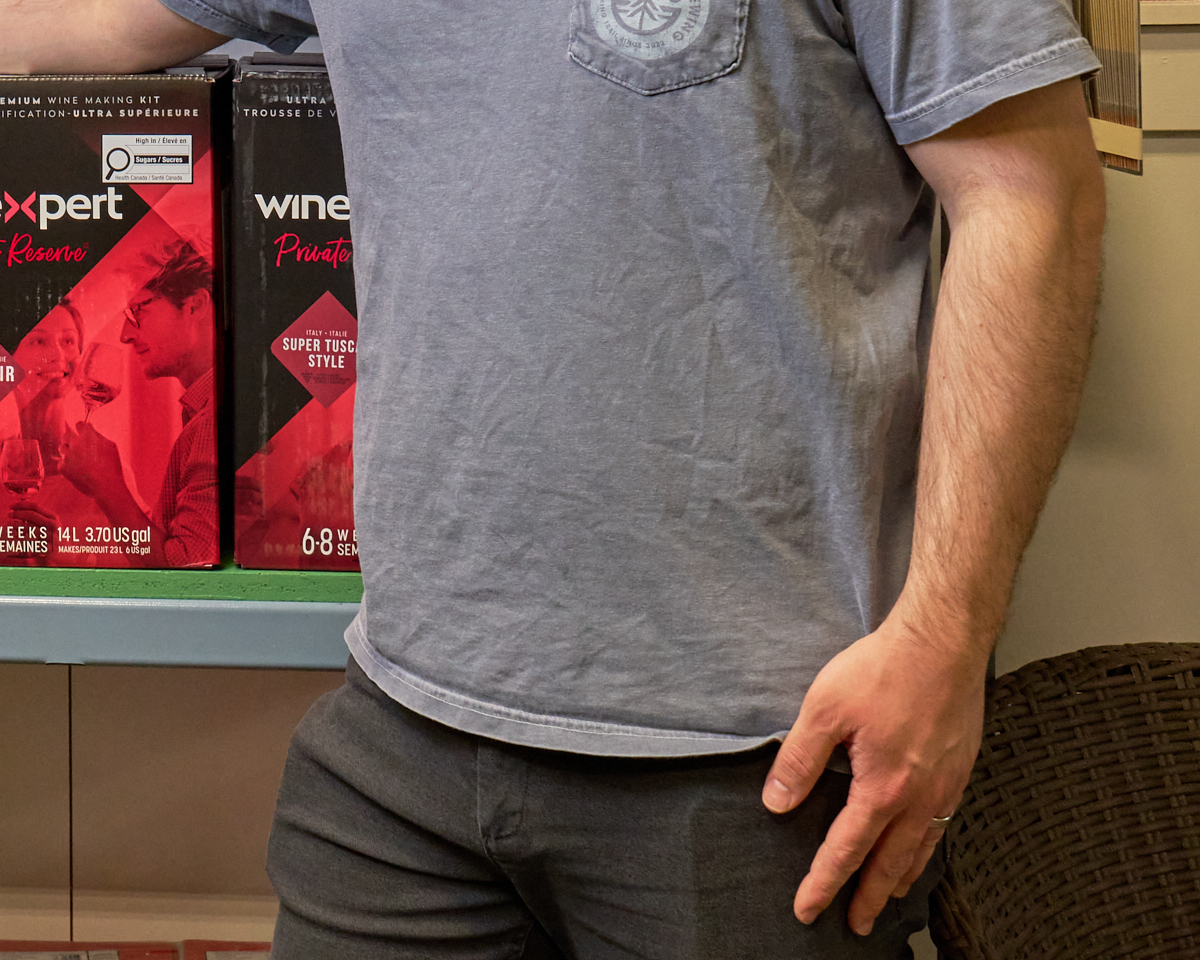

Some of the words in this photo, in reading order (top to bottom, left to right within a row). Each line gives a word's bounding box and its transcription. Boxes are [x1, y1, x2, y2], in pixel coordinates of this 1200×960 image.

[7, 233, 87, 268] Reserve
[274, 232, 352, 269] Private
[283, 337, 320, 352] SUPER
[308, 354, 345, 368] STYLE
